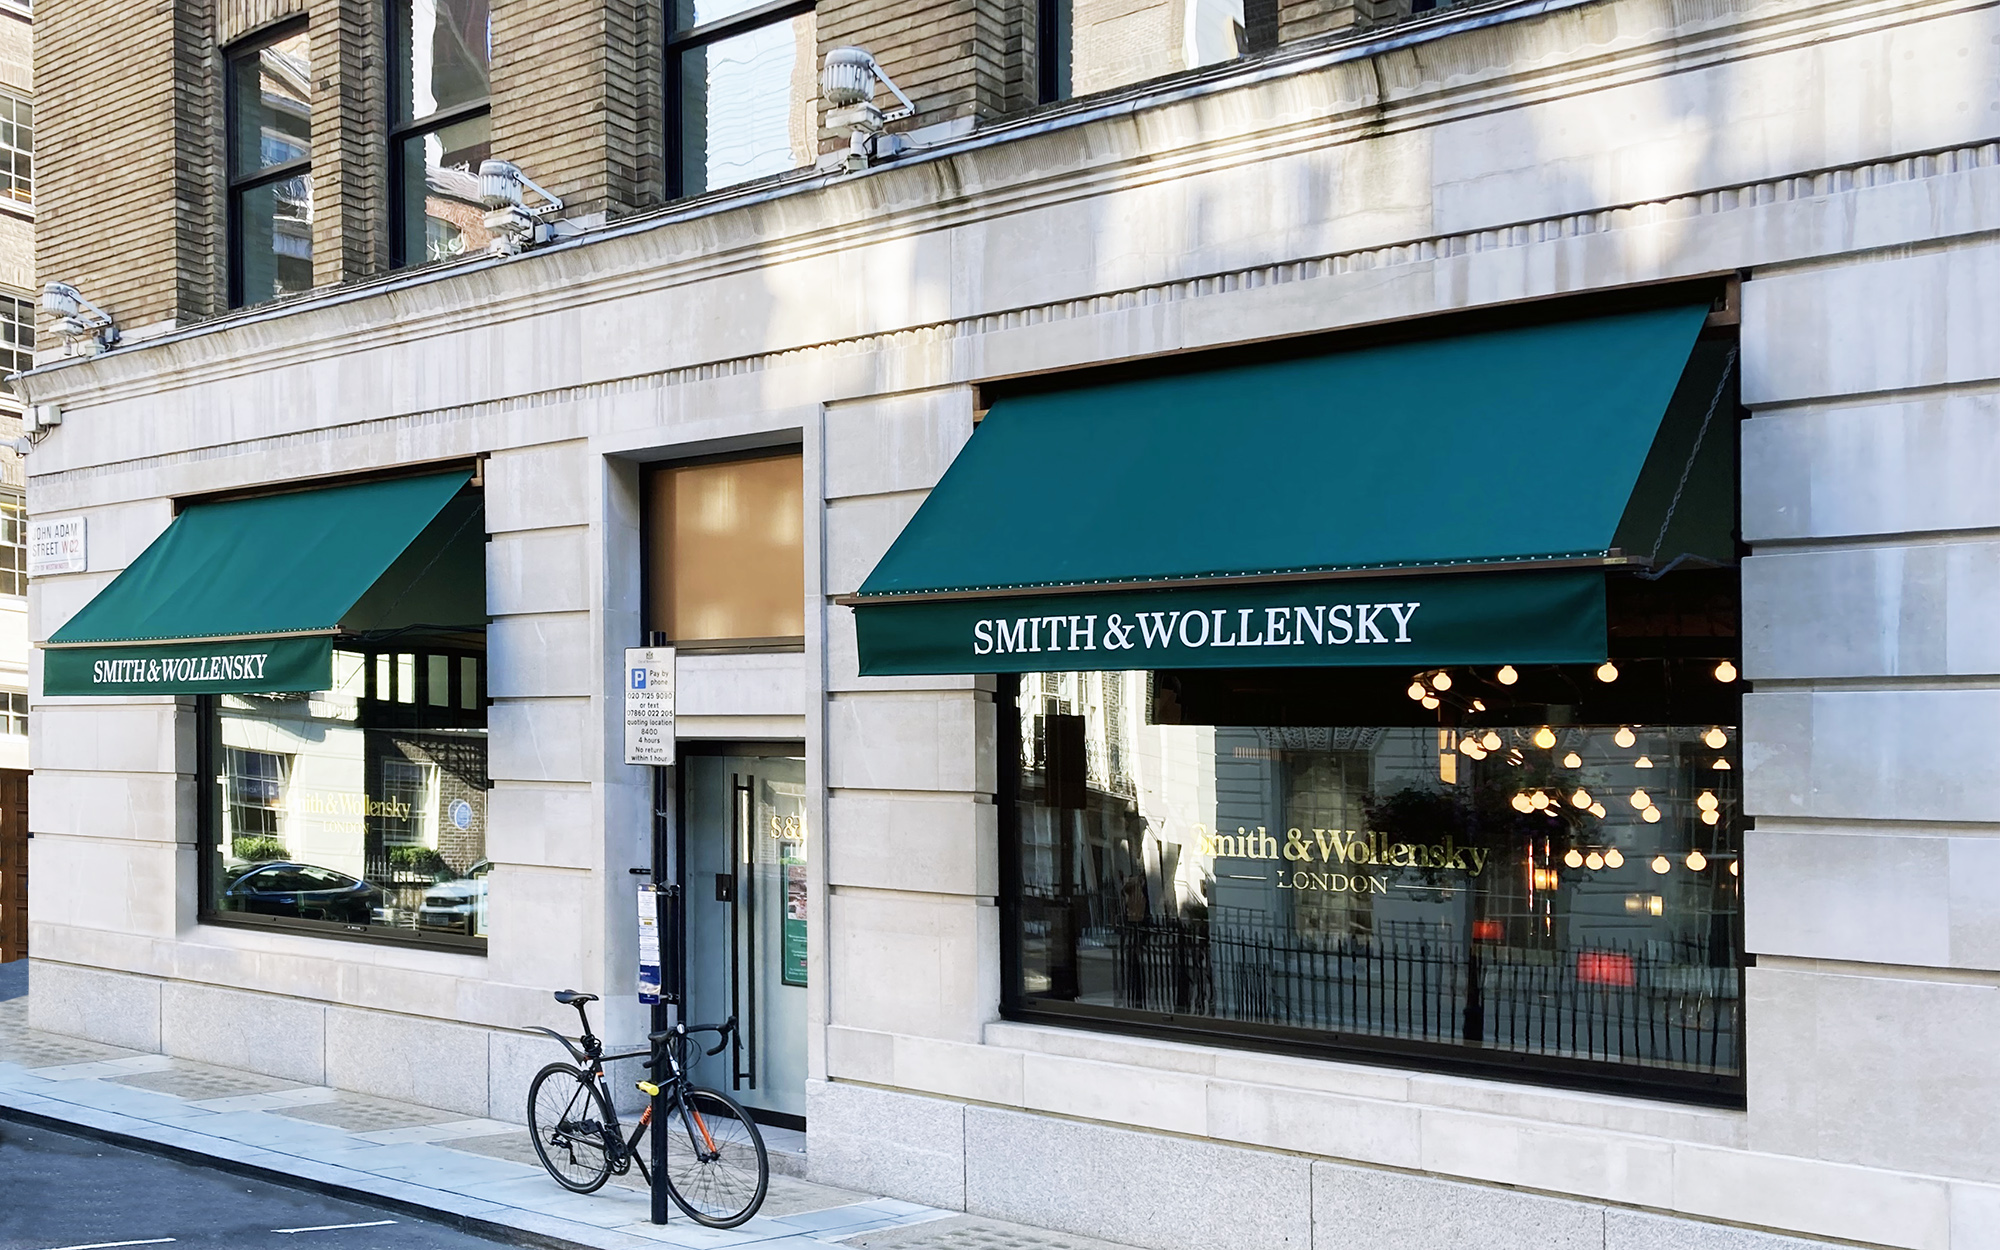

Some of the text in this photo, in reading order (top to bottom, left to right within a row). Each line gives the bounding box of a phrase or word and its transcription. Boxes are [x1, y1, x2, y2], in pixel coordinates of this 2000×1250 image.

[32, 523, 78, 540] JOHN ADAM
[32, 539, 79, 557] STREET WC2
[635, 669, 669, 687] P Pay by
[650, 679, 668, 687] phone
[339, 793, 411, 822] Wollensky
[322, 820, 371, 836] LONDON
[1191, 824, 1279, 861] Smith
[1312, 828, 1490, 877] Wollensky
[1276, 870, 1389, 895] LONDON
